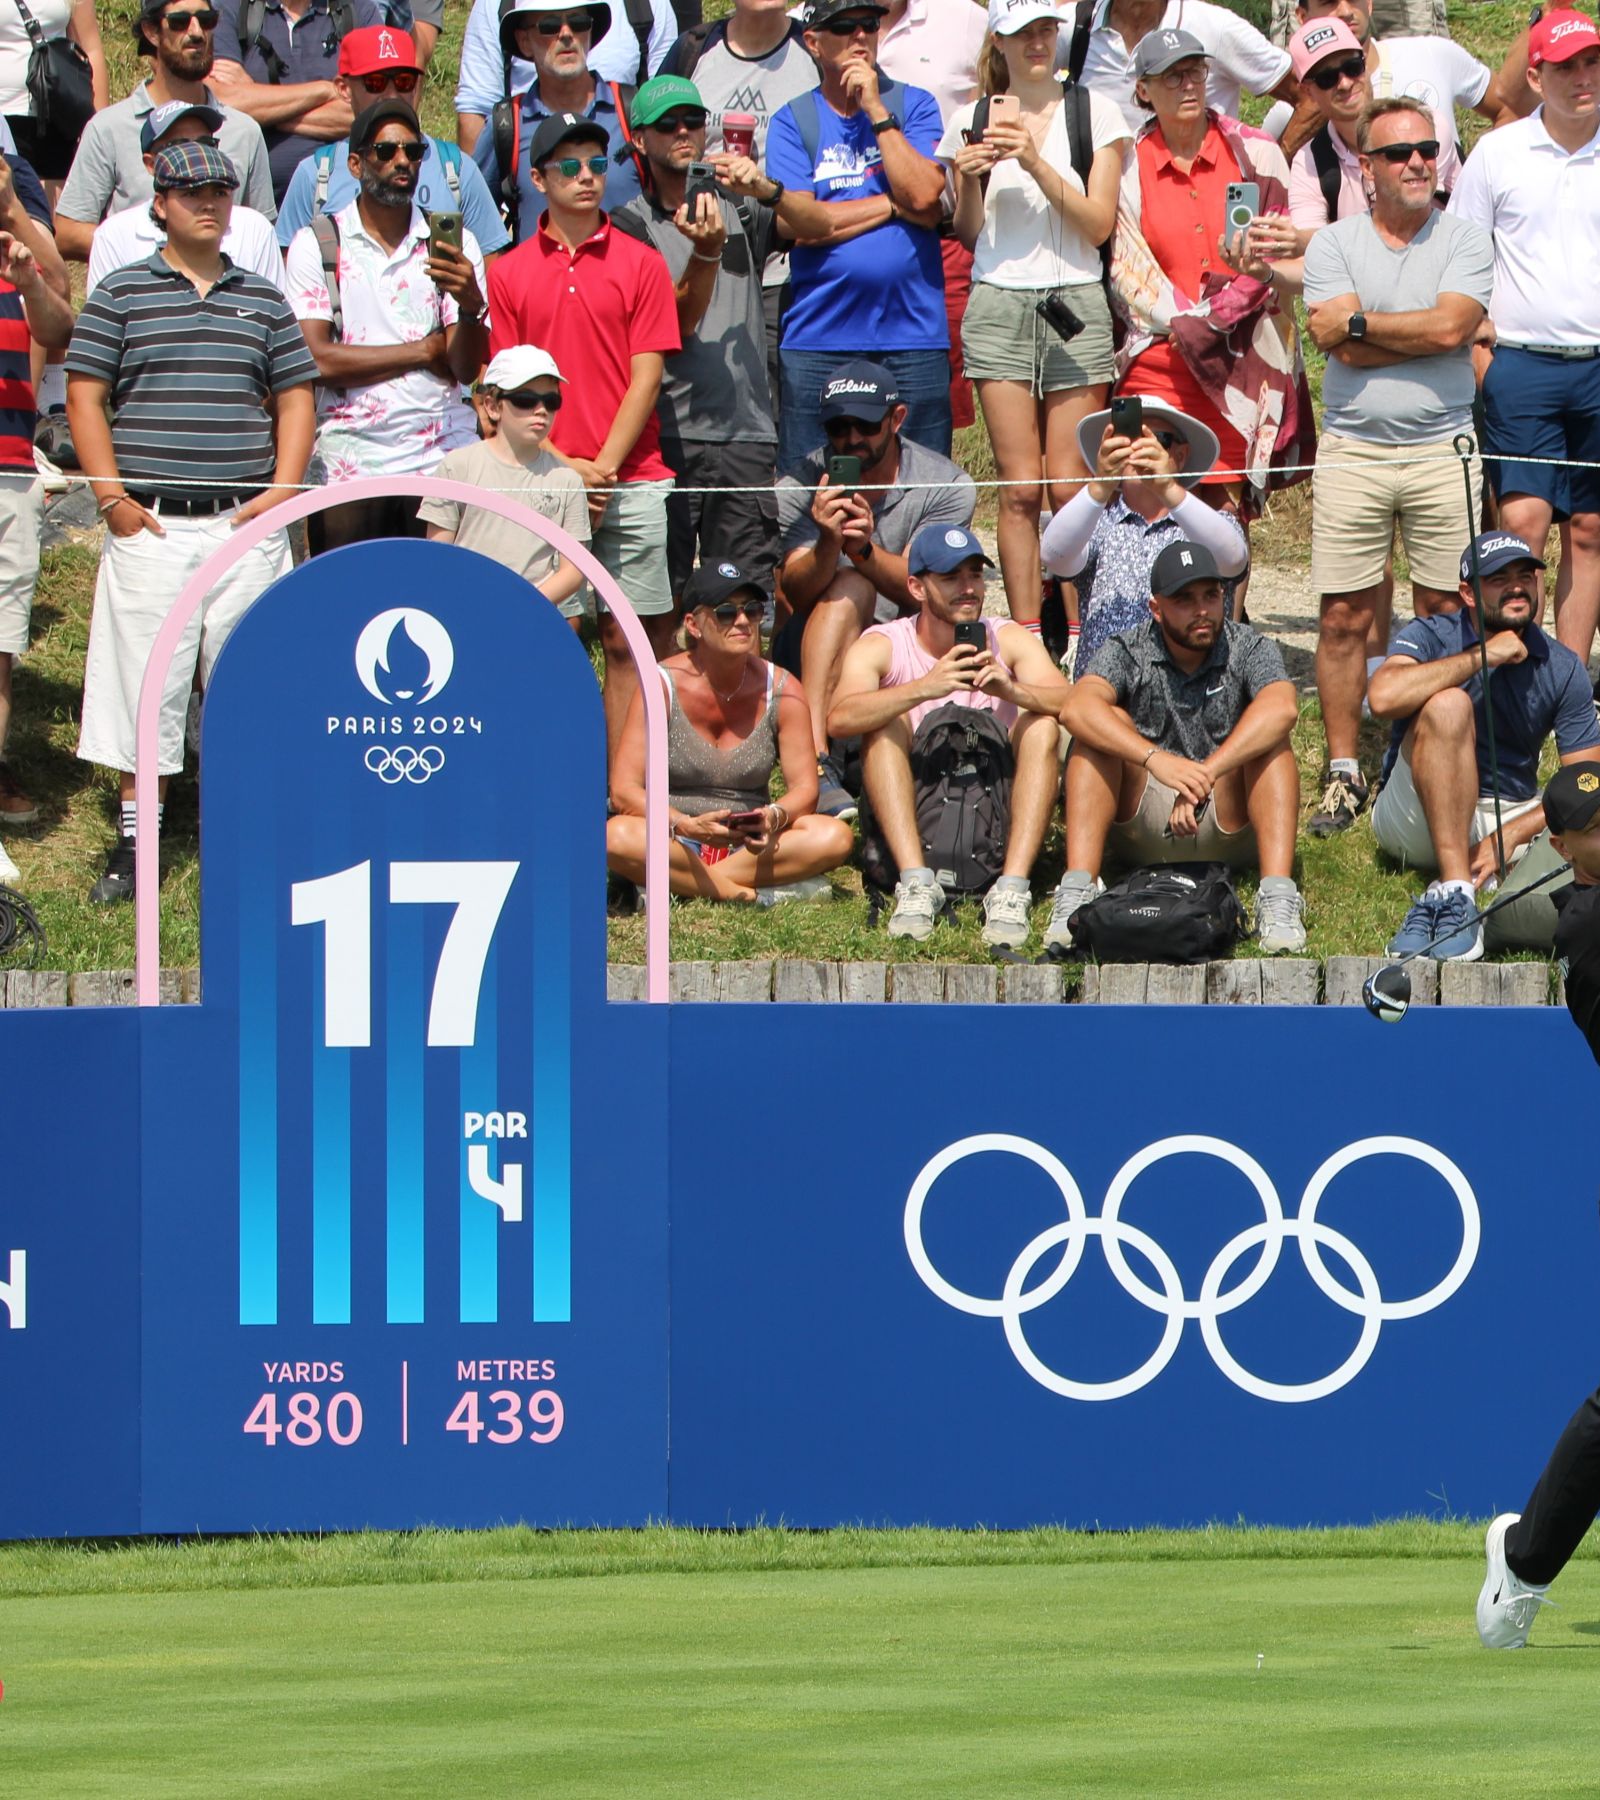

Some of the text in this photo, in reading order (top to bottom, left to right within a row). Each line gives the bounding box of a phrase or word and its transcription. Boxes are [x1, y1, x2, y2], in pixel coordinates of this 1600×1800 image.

[1307, 29, 1334, 46] GOLF
[156, 100, 194, 122] Titl
[825, 378, 878, 399] Titleist
[1480, 536, 1530, 558] Titleist
[327, 716, 482, 735] PARIS 2024
[291, 859, 520, 1047] 17
[464, 1112, 527, 1139] PAR
[468, 1145, 523, 1222] 4
[263, 1361, 345, 1383] YARDS
[457, 1360, 556, 1381] METRES
[243, 1391, 364, 1447] 480
[446, 1389, 565, 1444] 439
